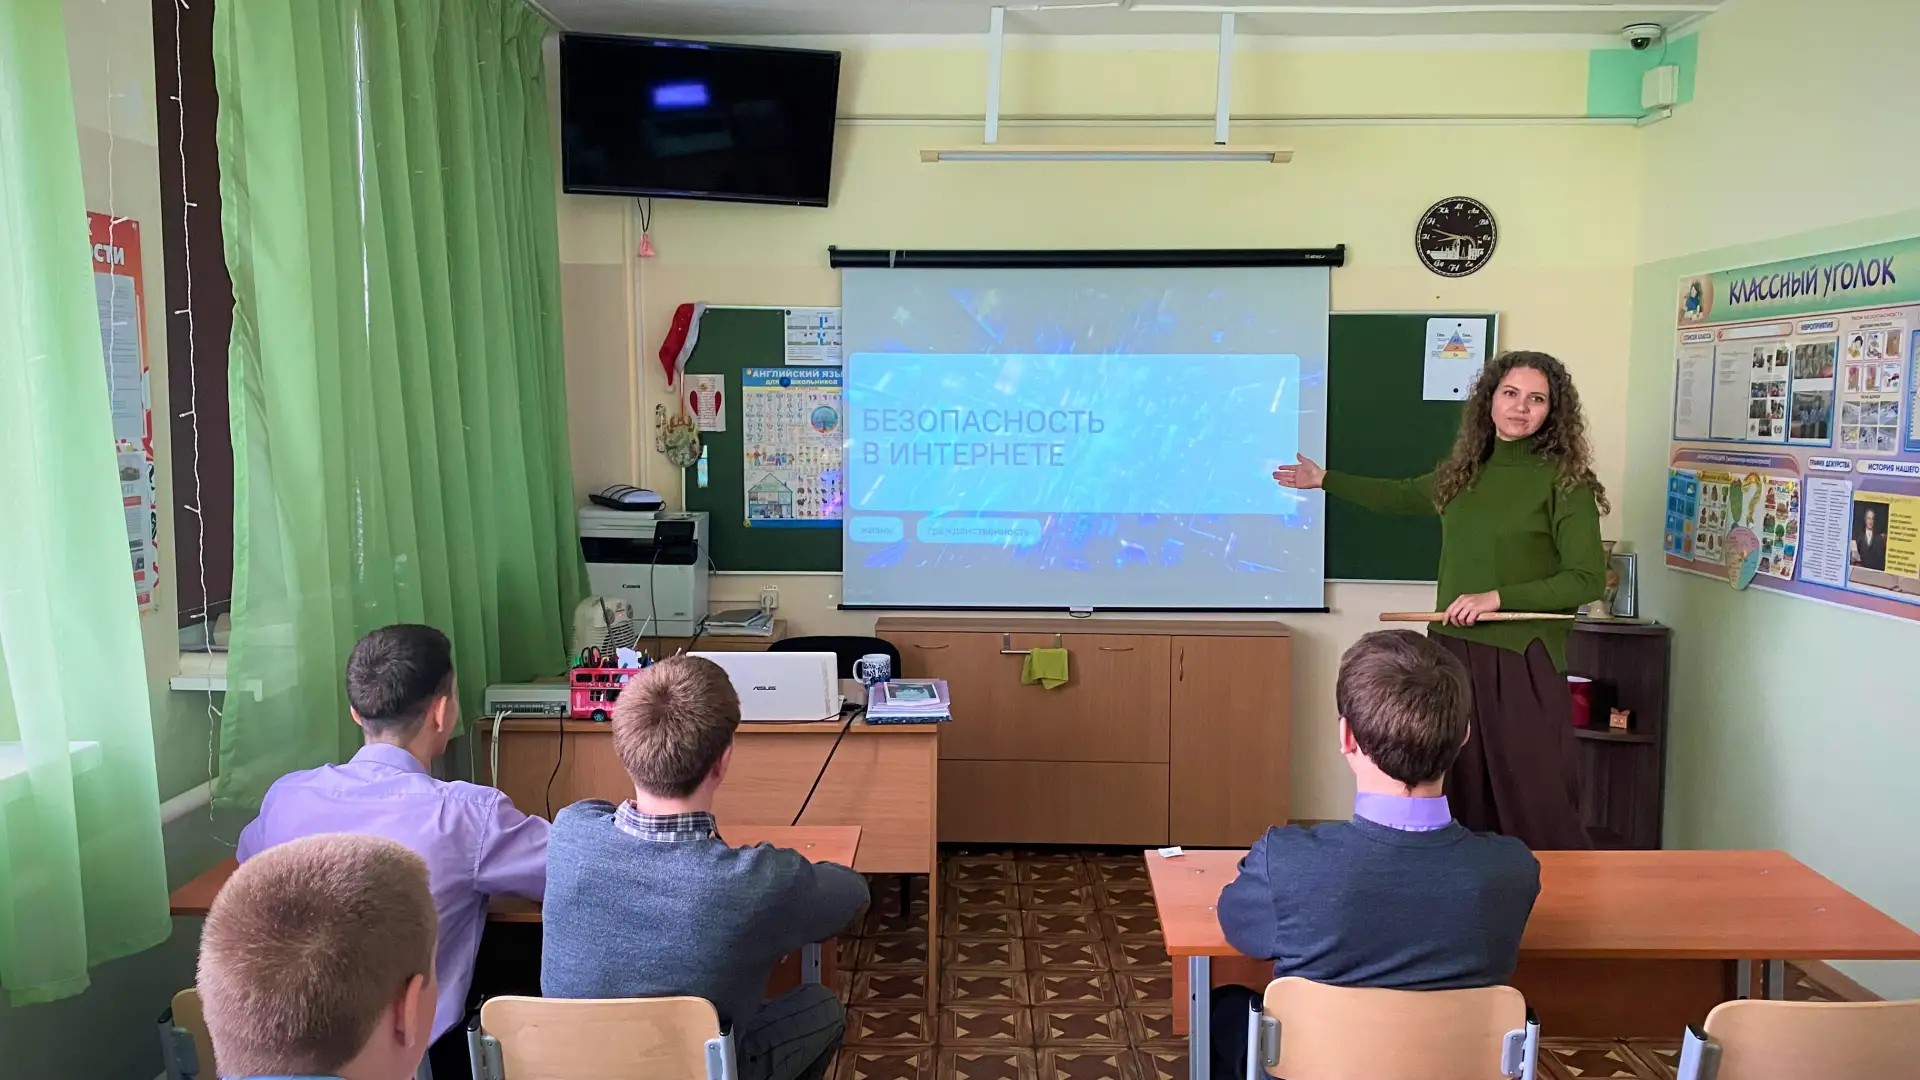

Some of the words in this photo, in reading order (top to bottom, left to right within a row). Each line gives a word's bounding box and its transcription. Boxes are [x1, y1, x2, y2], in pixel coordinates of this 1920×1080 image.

[92, 243, 125, 265] СТИ
[1729, 263, 1818, 306] КЛАССНЫЙ
[1823, 256, 1897, 295] УГОЛОК
[752, 369, 819, 378] АНГЛИЙСКИЙ
[863, 408, 1105, 434] БЕЗОПАСНОСТЬ
[864, 442, 879, 465] В
[890, 442, 1065, 467] ИНТЕРНЕТЕ
[1826, 460, 1850, 469] ДЕЖУРСТВА
[1867, 463, 1895, 471] ИСТОРИЯ
[1895, 465, 1919, 473] НАШЕГО
